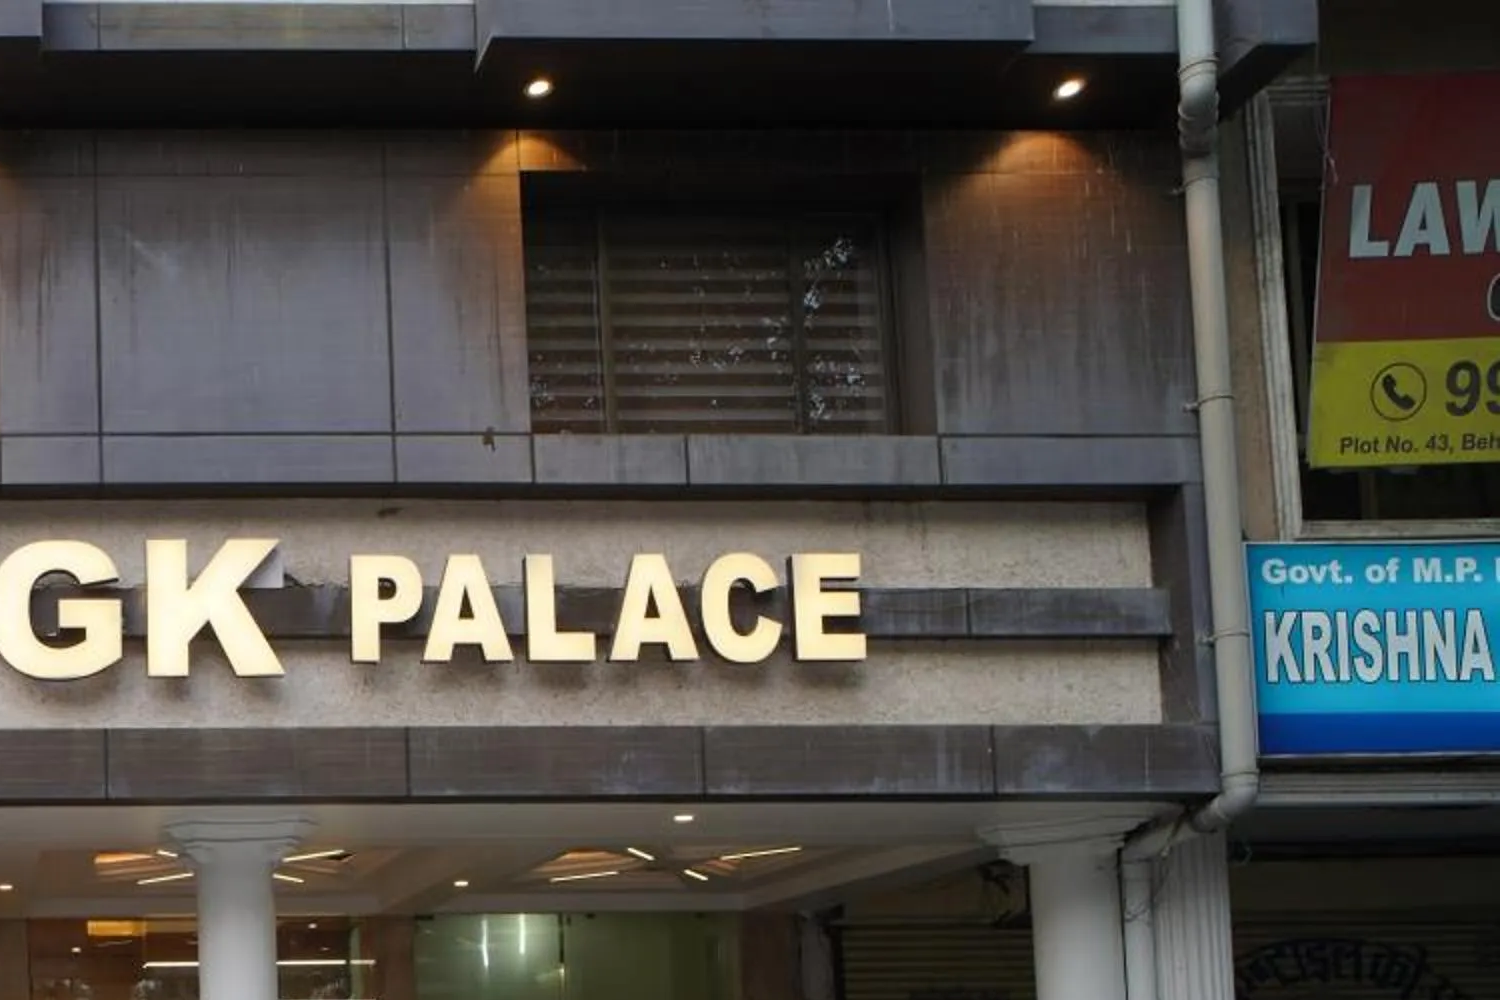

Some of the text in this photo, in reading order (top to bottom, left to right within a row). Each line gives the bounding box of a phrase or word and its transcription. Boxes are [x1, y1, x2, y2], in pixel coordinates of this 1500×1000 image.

[1340, 436, 1379, 455] Plot
[1385, 435, 1419, 454] No.
[1425, 433, 1455, 455] 43,
[1261, 558, 1353, 585] Govt.
[1364, 556, 1401, 584] of
[1412, 557, 1483, 584] M.P.
[350, 552, 867, 664] PALACE
[1263, 608, 1496, 683] KRISHNA
